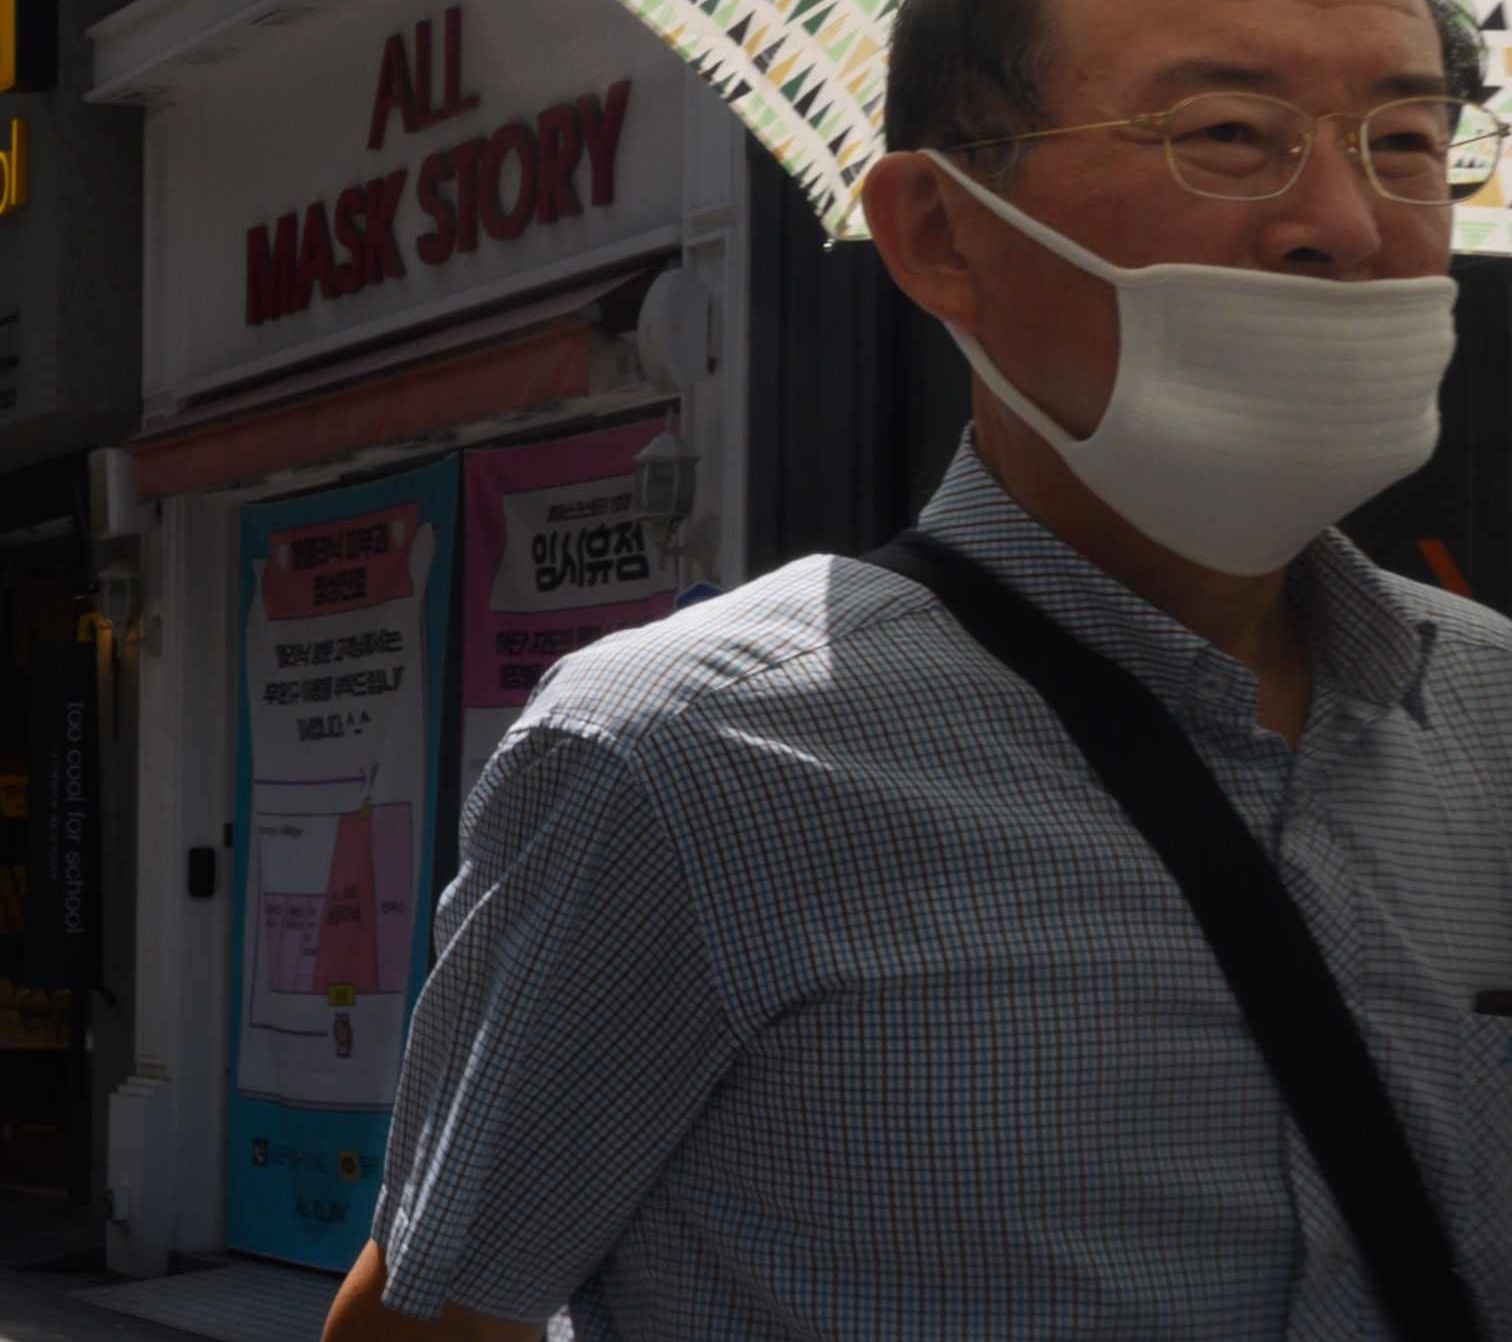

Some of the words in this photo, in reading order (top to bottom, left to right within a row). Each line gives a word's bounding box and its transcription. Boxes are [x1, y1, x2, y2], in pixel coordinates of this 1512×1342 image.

[368, 6, 479, 150] ALL
[245, 168, 407, 327] MASK
[416, 80, 632, 266] STORY
[531, 520, 650, 593] 임시휴점
[63, 701, 87, 742] too
[63, 747, 87, 803] cool
[63, 809, 87, 845] for
[63, 850, 87, 936] school
